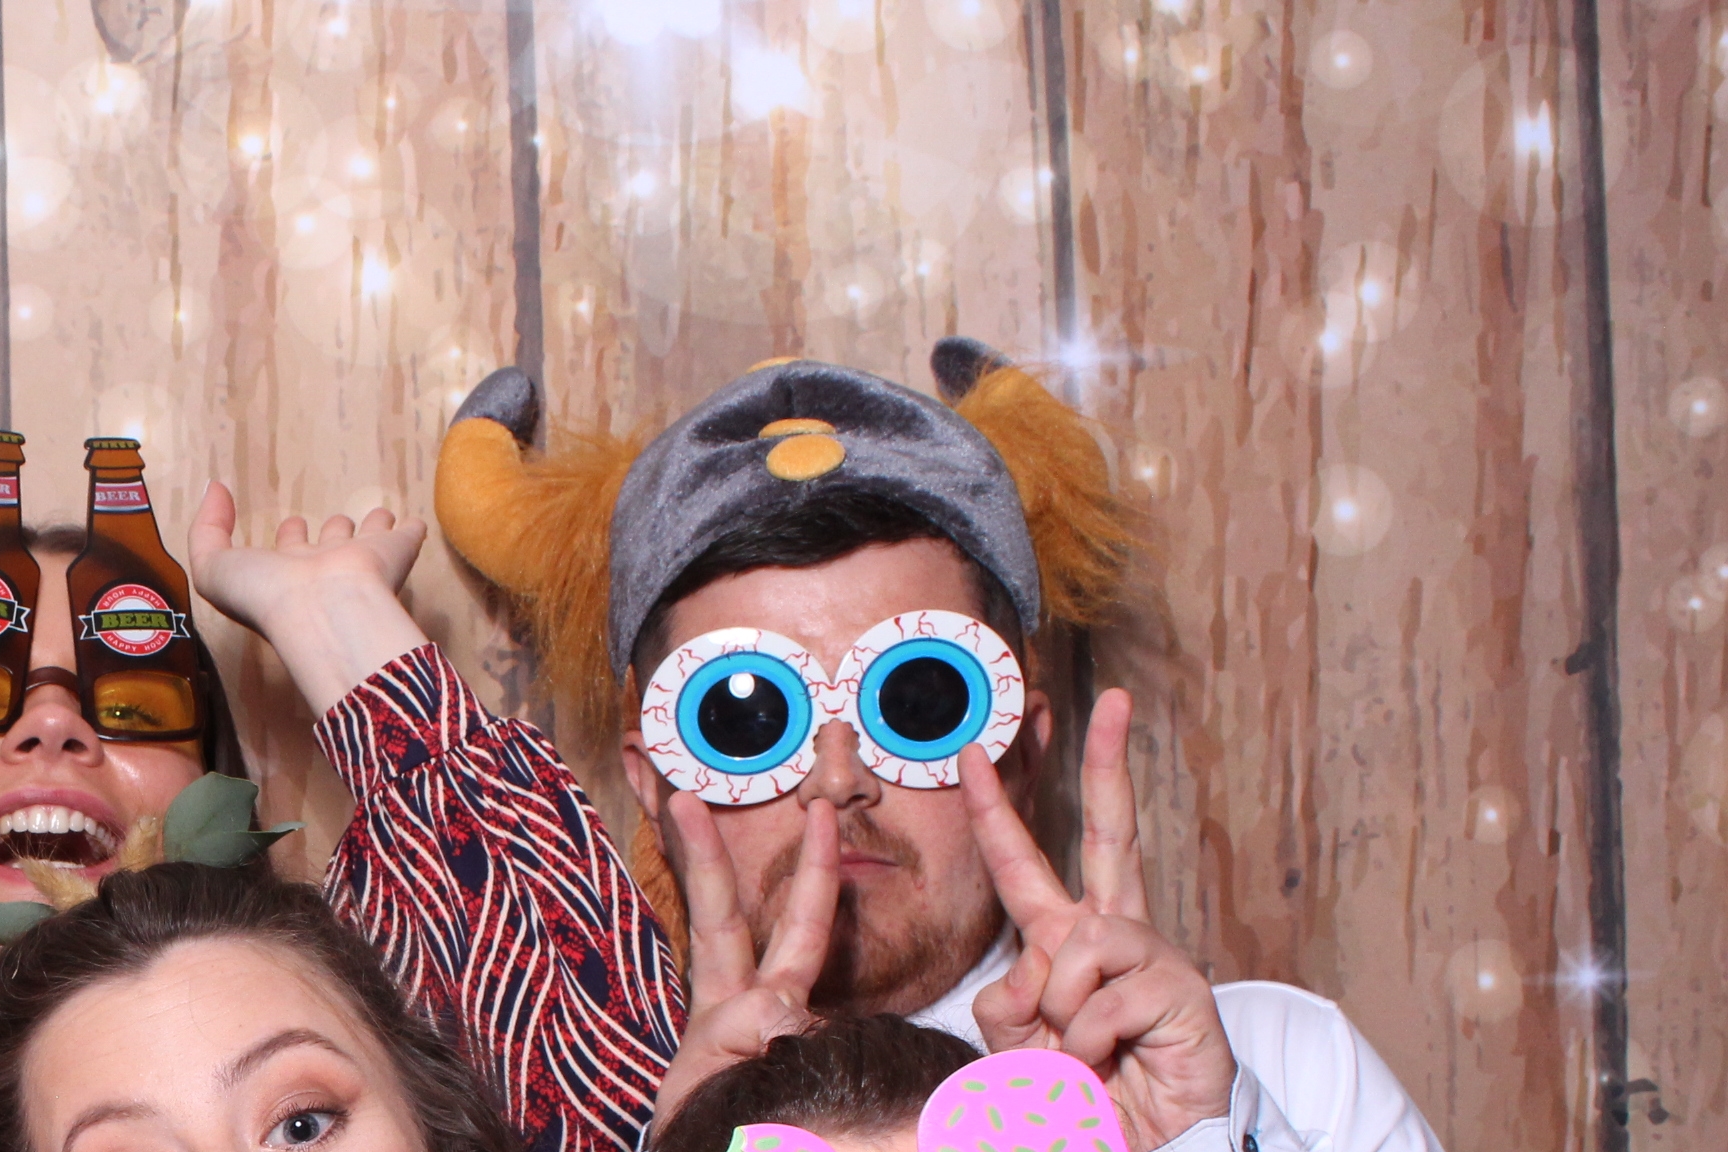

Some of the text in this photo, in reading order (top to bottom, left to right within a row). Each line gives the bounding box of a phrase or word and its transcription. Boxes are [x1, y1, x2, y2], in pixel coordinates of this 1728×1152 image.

[95, 490, 141, 502] BEER
[102, 588, 162, 607] HAPPY HOUR
[100, 612, 170, 629] BEER
[106, 634, 166, 652] HAPPY HOUR
